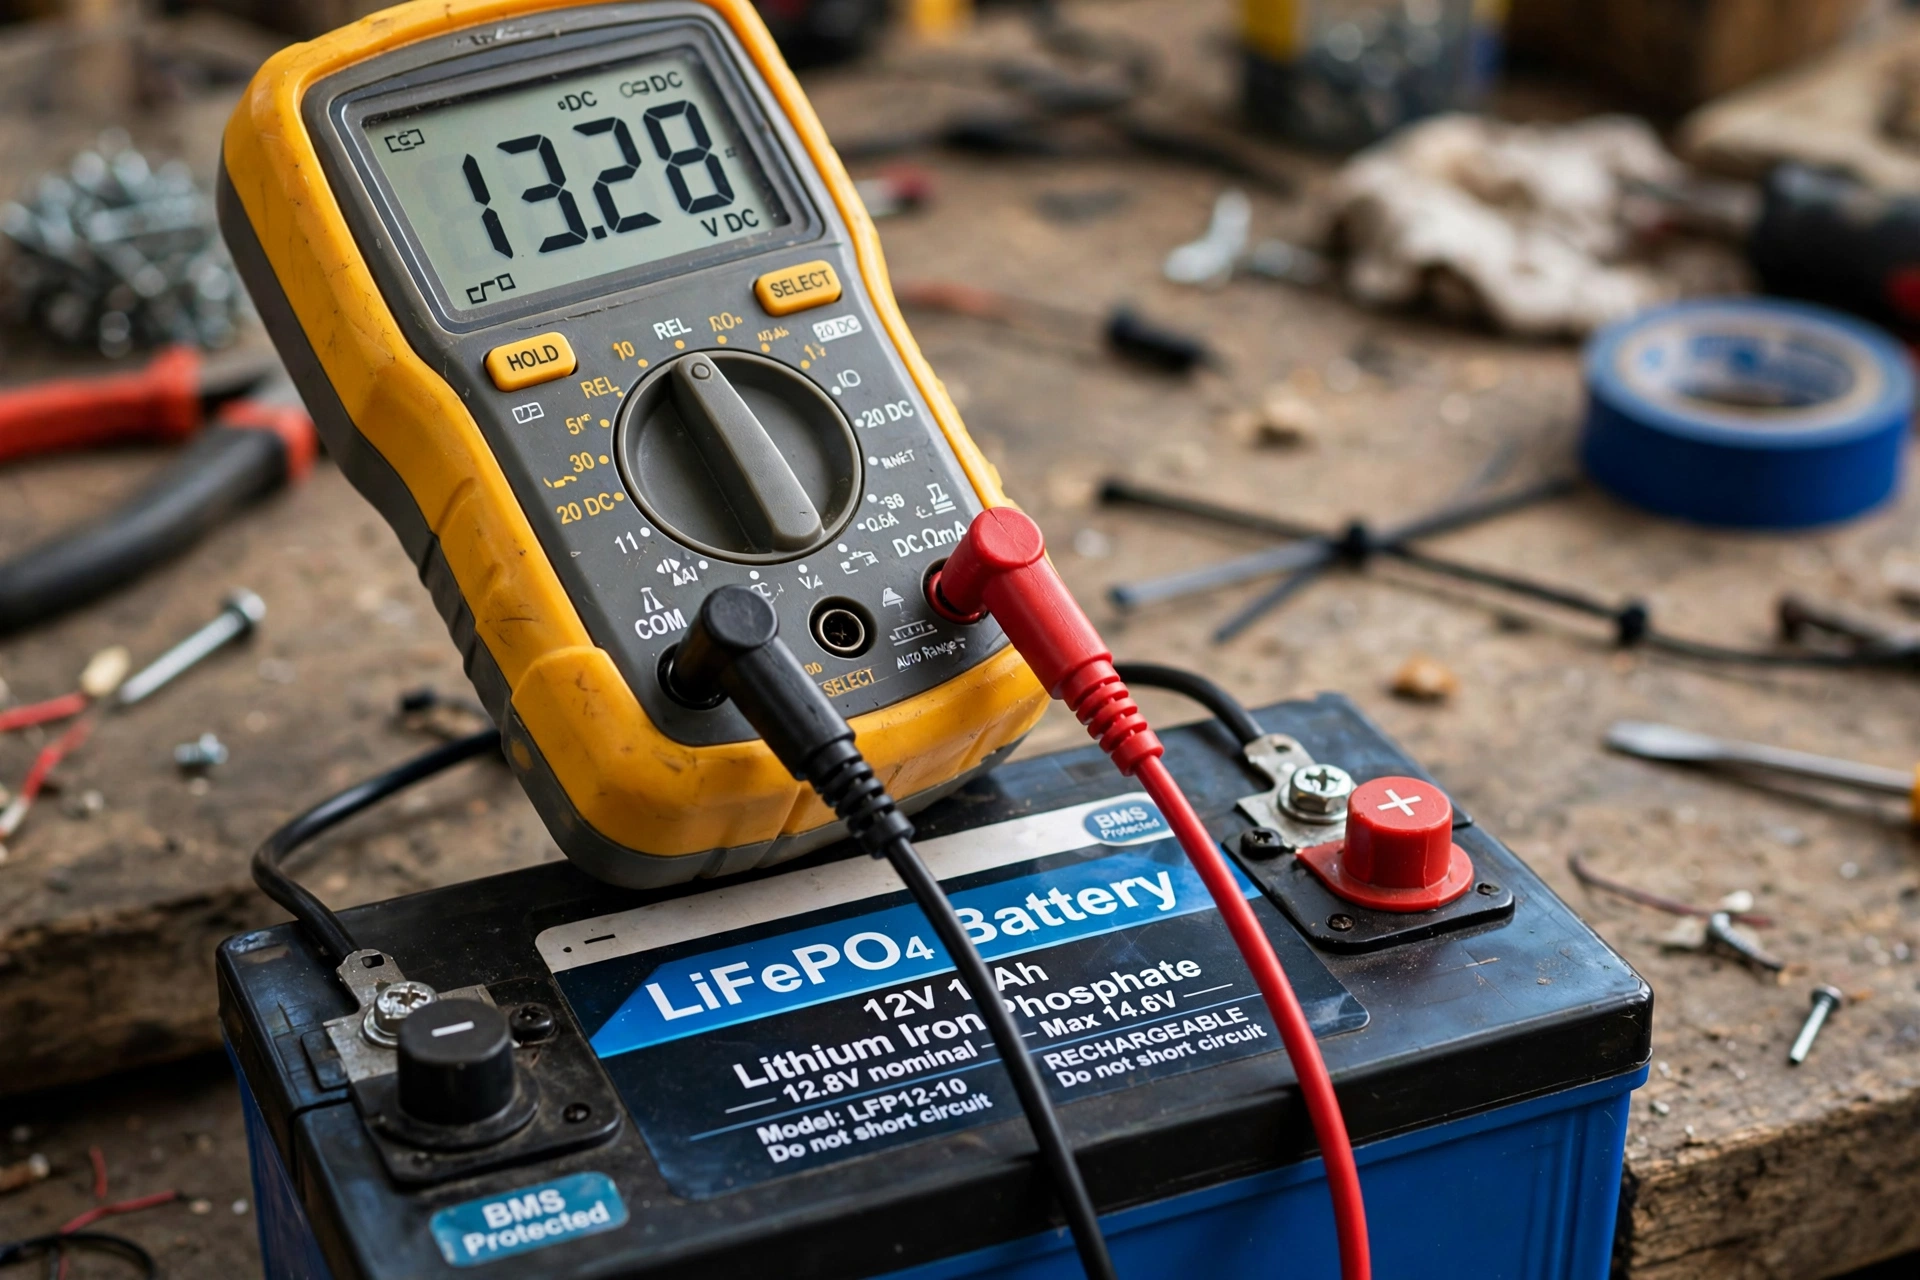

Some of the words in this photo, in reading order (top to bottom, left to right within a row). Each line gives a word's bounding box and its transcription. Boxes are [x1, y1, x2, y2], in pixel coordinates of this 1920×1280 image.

[462, 100, 735, 259] 13.28
[701, 218, 718, 238] V
[724, 208, 760, 235] DC
[770, 270, 832, 299] SELECT
[653, 318, 692, 340] REL
[507, 344, 559, 372] HOLD
[861, 408, 885, 429] 20
[884, 400, 914, 423] DC
[569, 452, 594, 473] 30
[556, 501, 582, 525] 20
[584, 493, 615, 518] DC
[614, 531, 639, 554] 11
[892, 534, 924, 558] DC
[634, 608, 687, 640] COM
[822, 668, 876, 698] SELECT
[1093, 806, 1148, 829] BMS
[1100, 818, 1161, 839] Protected
[953, 870, 1176, 945] Battery
[863, 985, 935, 1022] 12V
[947, 961, 1049, 1001] 1Ah
[733, 1031, 895, 1089] Lithium
[898, 1012, 987, 1048] Iron
[782, 1067, 860, 1104] 12.8V
[867, 1039, 978, 1082] nominal
[1041, 1012, 1102, 1038] Max
[1102, 990, 1177, 1023] 14.6V
[1043, 1006, 1248, 1071] RECHARGEABLE
[1056, 1068, 1093, 1089] Do
[1095, 1058, 1135, 1080] not
[1134, 1041, 1195, 1067] short
[1197, 1022, 1267, 1053] circuit
[756, 1110, 845, 1145] Model:
[847, 1078, 968, 1122] LFP12-10
[767, 1138, 806, 1163] Do
[810, 1130, 852, 1153] not
[853, 1111, 918, 1141] short
[919, 1092, 993, 1123] circuit
[481, 1189, 566, 1229] BMS
[462, 1200, 611, 1257] Protected
